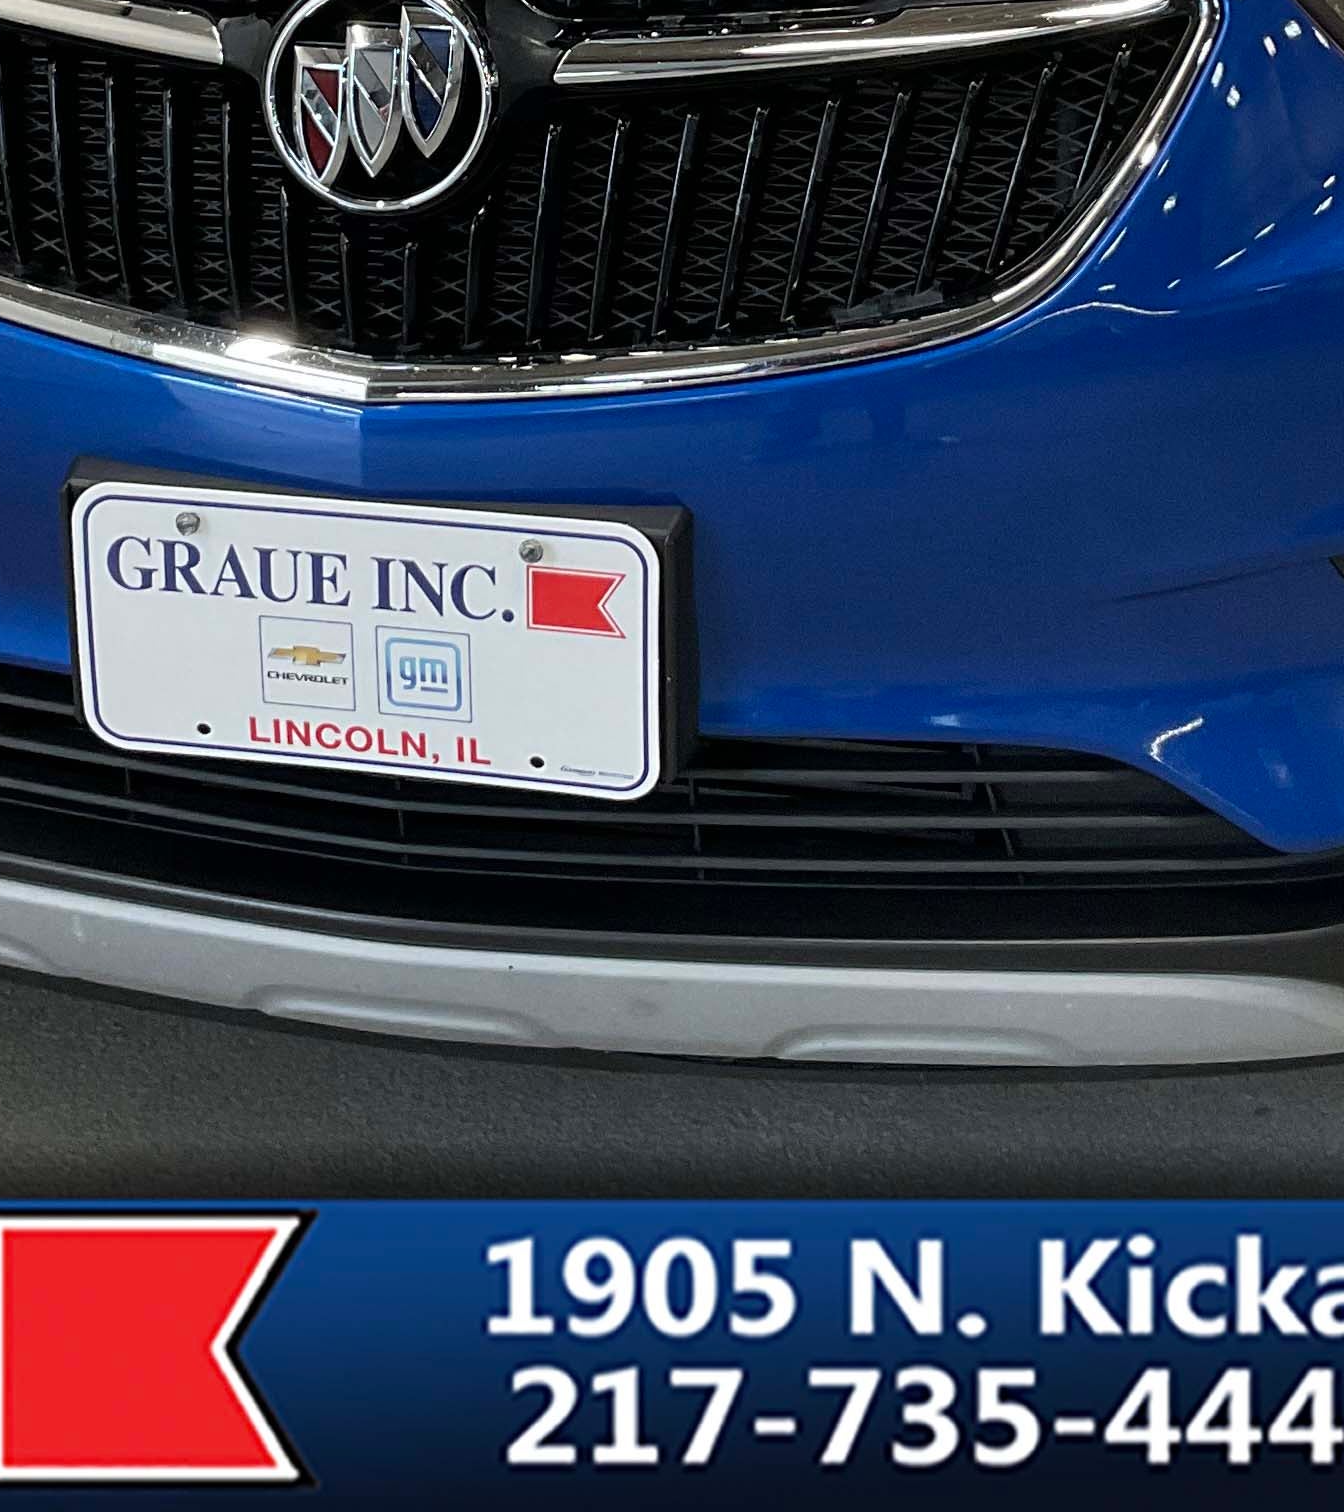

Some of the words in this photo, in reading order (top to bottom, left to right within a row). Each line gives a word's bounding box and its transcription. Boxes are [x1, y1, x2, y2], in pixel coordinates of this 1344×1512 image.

[106, 535, 351, 608] GRAUE
[372, 557, 515, 624] INC.
[267, 670, 349, 686] CHEVROLET
[399, 655, 449, 693] gm
[248, 716, 441, 764] LINCOLN,
[455, 736, 492, 766] IL
